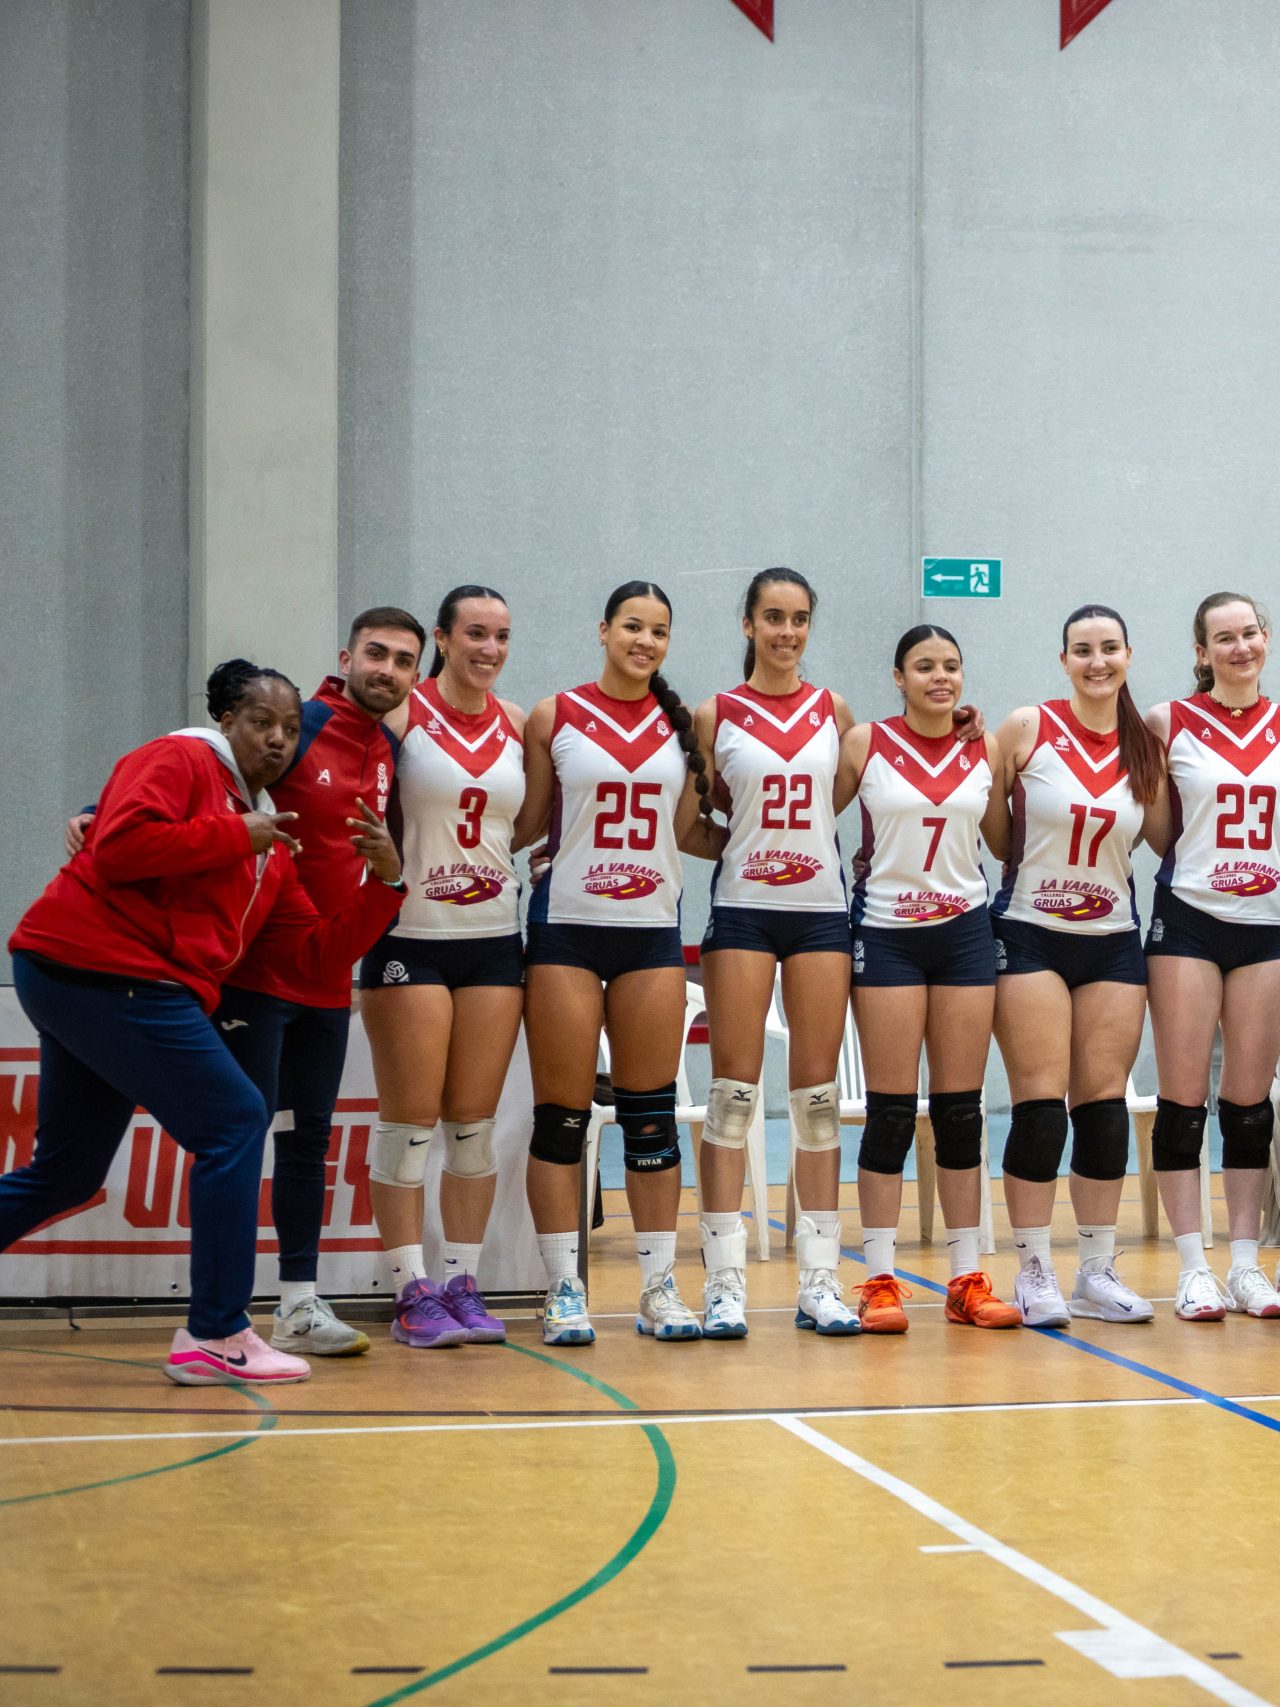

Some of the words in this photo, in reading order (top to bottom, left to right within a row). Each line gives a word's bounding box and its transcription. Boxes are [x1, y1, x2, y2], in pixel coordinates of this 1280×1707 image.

[761, 774, 812, 830] 22
[457, 787, 488, 849] 3
[593, 781, 662, 851] 25
[1216, 783, 1277, 851] 23
[922, 817, 948, 872] 7
[1068, 803, 1117, 867] 17
[742, 865, 775, 876] GRUAS
[748, 851, 760, 861] LA
[765, 850, 824, 871] VARIANTE
[1214, 862, 1229, 873] LA
[428, 864, 445, 879] LA
[450, 863, 510, 885] VARIANTE
[585, 879, 619, 890] GRUAS
[588, 864, 604, 875] LA
[608, 863, 665, 885] VARIANTE
[1211, 876, 1244, 888] GRUAS
[425, 882, 462, 897] GRUAS
[1040, 879, 1057, 890] LA
[1062, 879, 1120, 905] VARIANTE
[894, 906, 927, 915] GRUAS
[897, 892, 912, 902] LA
[917, 891, 971, 910] VARIANTE
[1033, 898, 1072, 907] GRUAS
